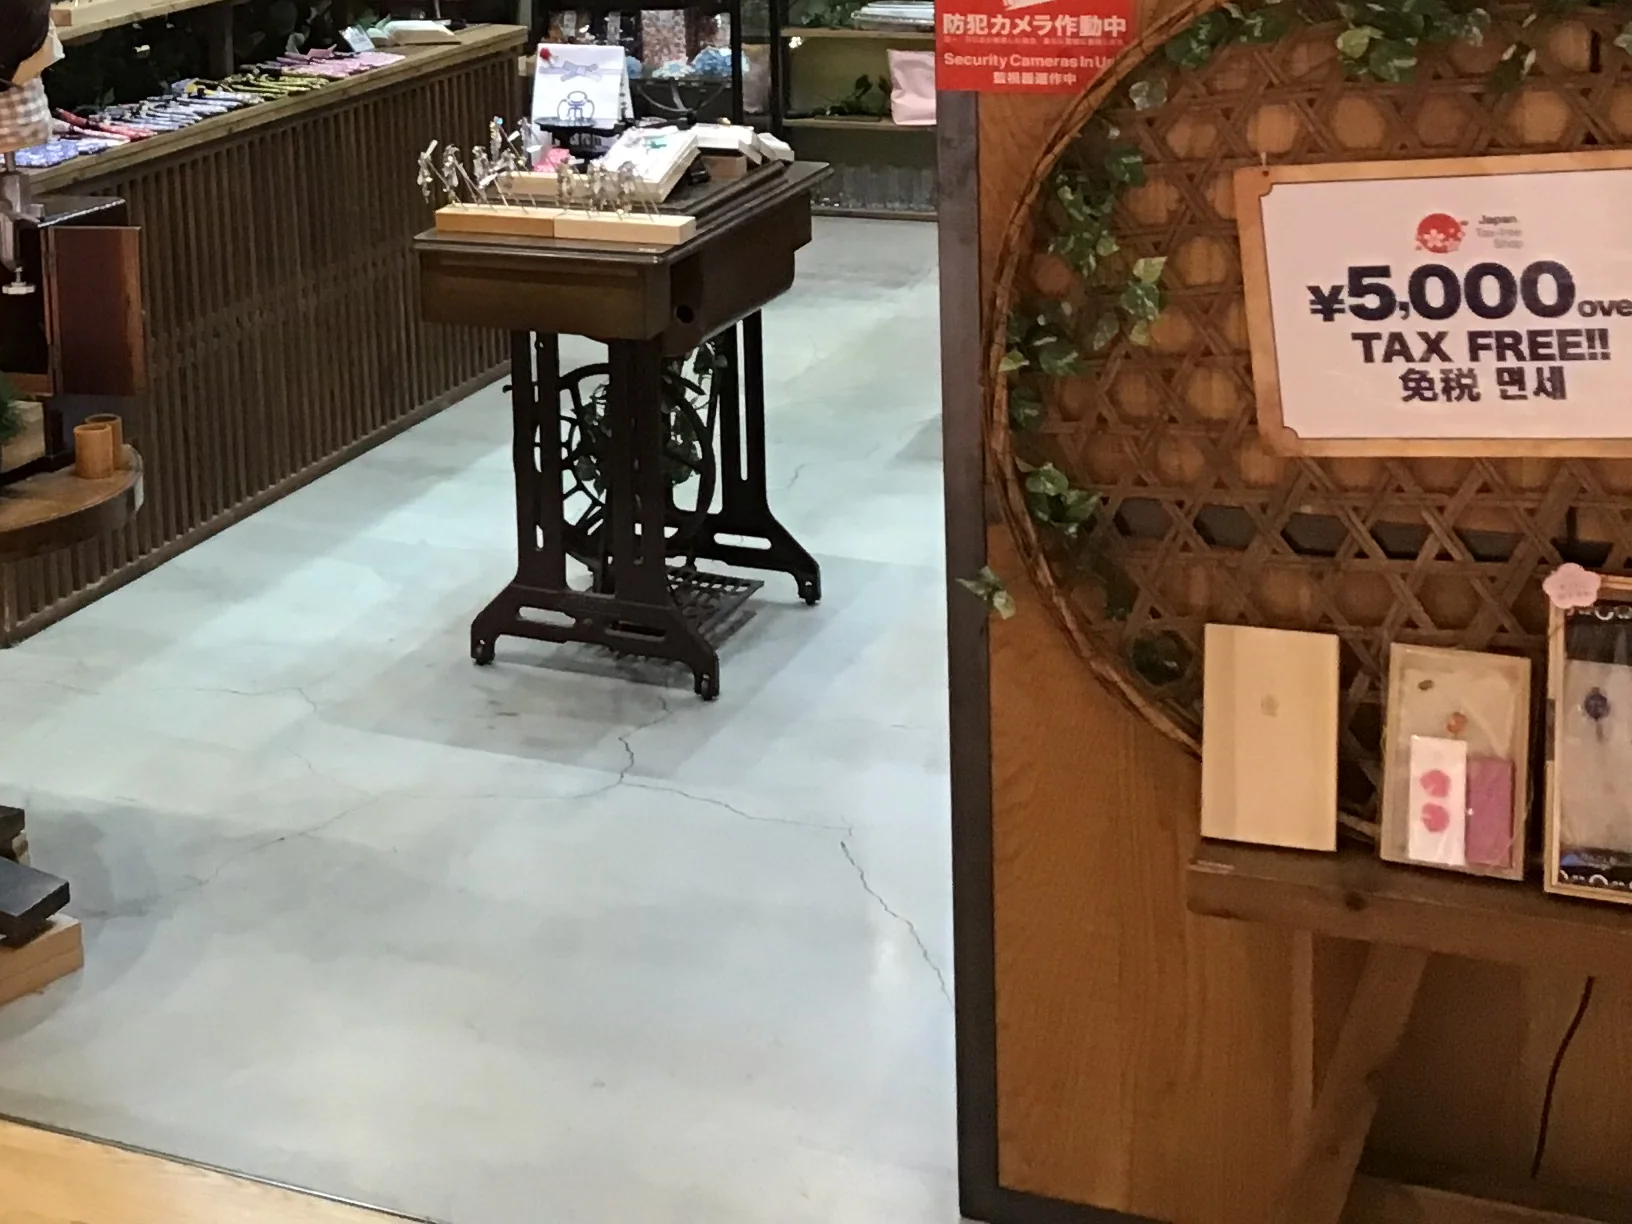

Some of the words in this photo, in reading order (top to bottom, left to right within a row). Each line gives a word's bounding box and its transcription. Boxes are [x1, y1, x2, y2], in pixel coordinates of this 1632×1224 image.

[943, 13, 1127, 37] 防犯カメラ作動中
[944, 53, 1008, 69] Security
[1010, 54, 1077, 68] Cameras
[1080, 56, 1093, 68] In
[1306, 260, 1576, 322] ¥5,000
[1578, 298, 1632, 318] ove
[1351, 331, 1453, 364] TAX
[1466, 328, 1611, 363] FREE!!
[1399, 367, 1481, 403] 免税
[1495, 366, 1568, 401] 면세
